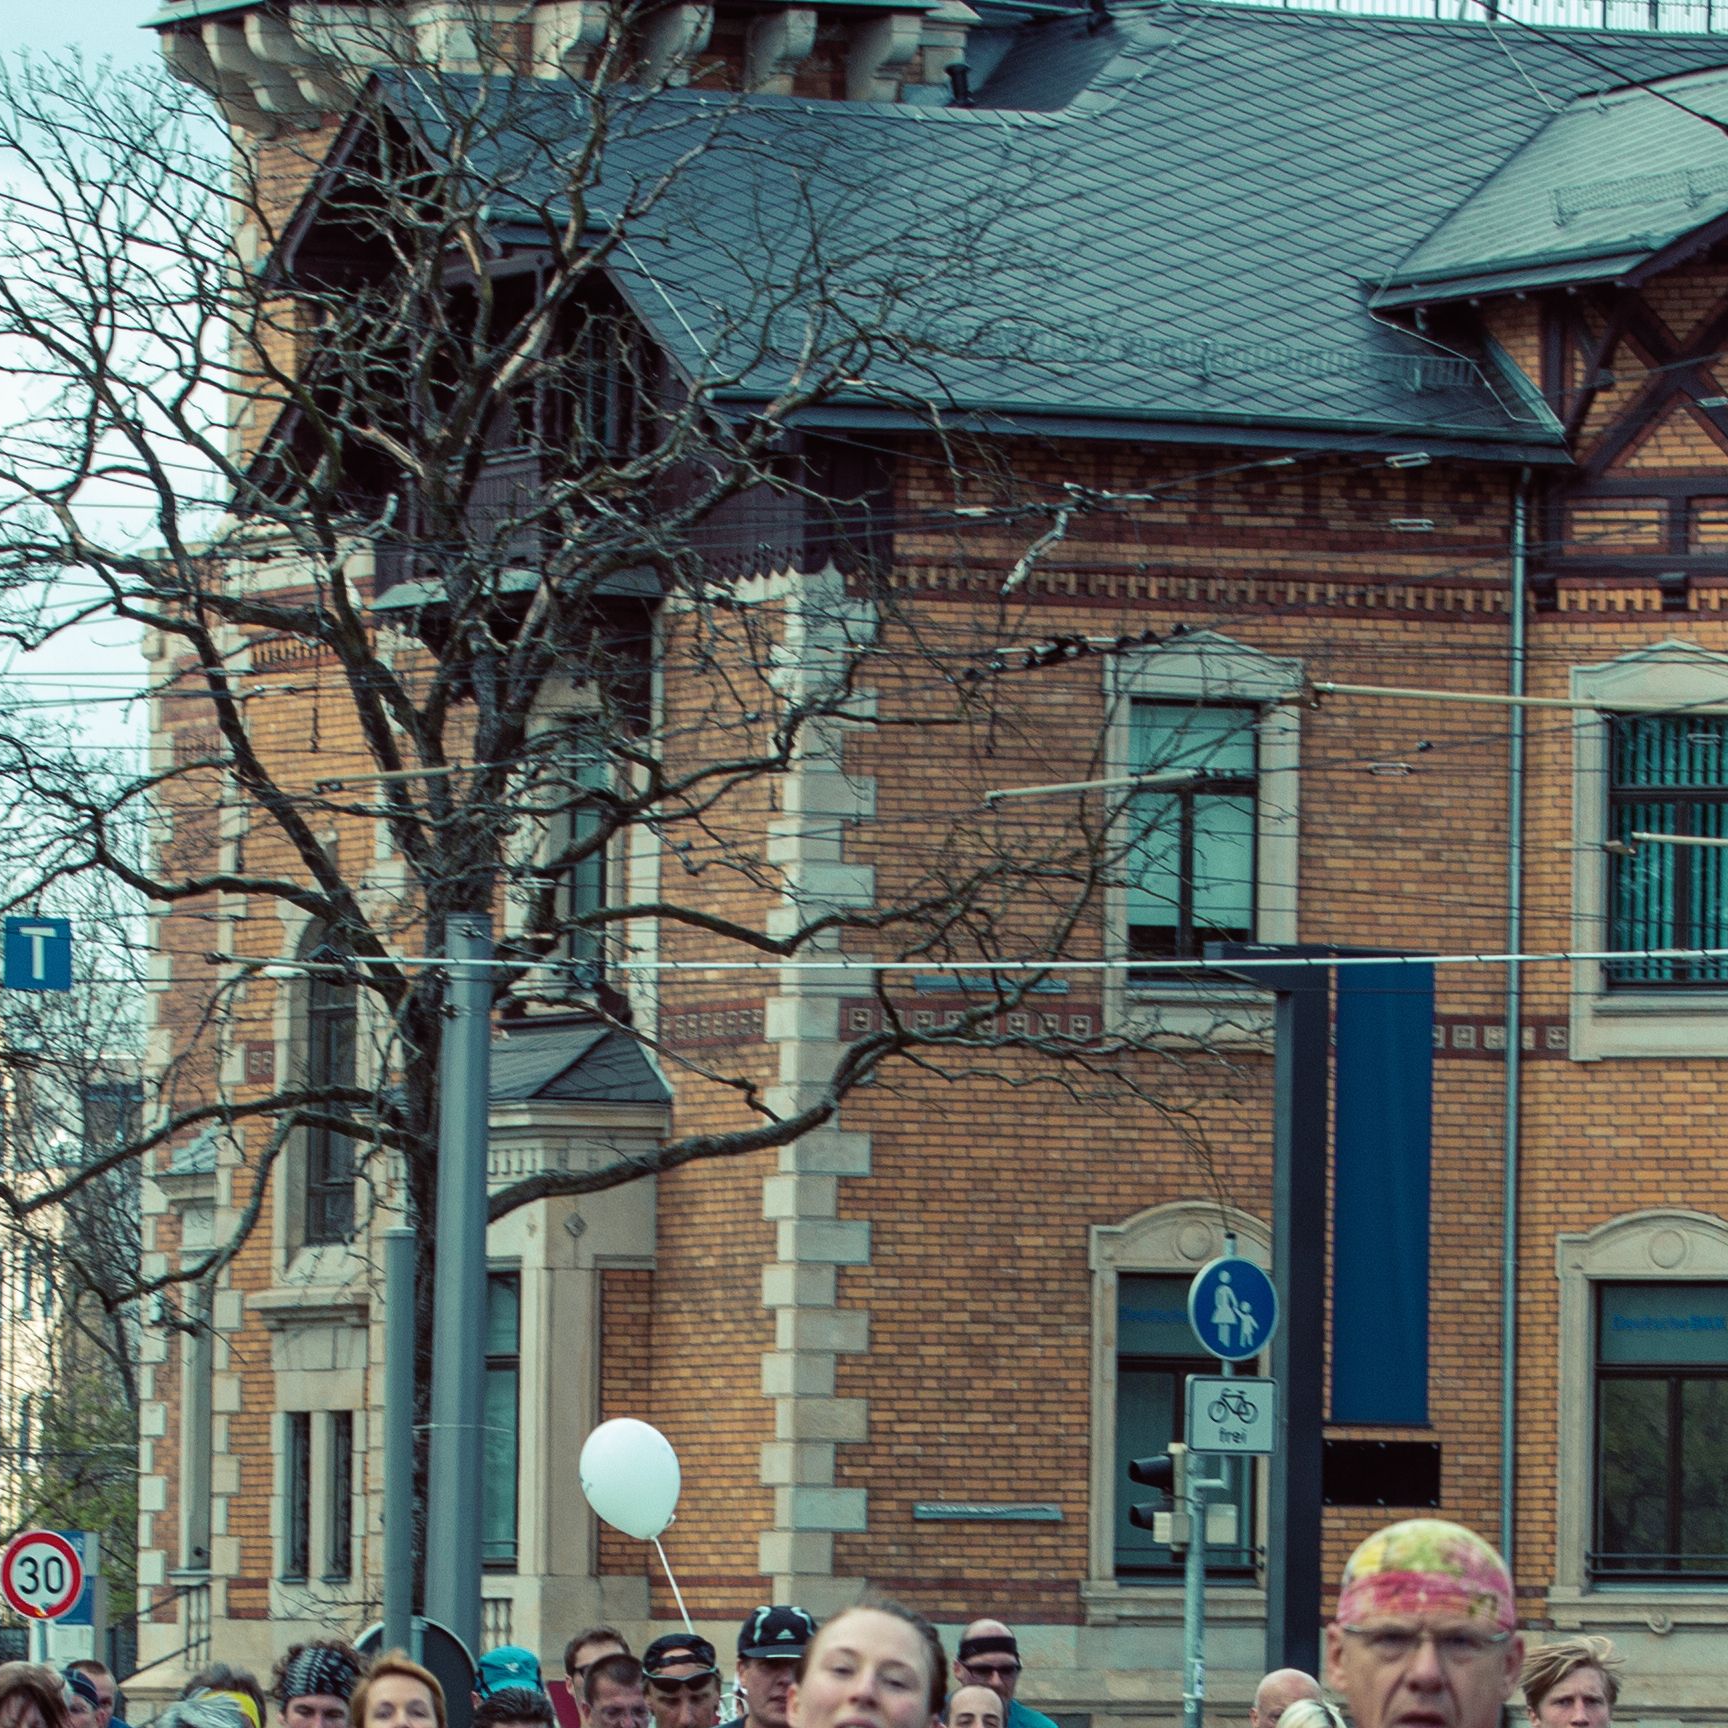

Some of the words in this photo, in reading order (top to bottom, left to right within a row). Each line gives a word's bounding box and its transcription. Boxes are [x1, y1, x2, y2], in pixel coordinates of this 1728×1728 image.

[19, 926, 57, 980] T
[1219, 1427, 1248, 1444] frei
[18, 1556, 64, 1594] 30
